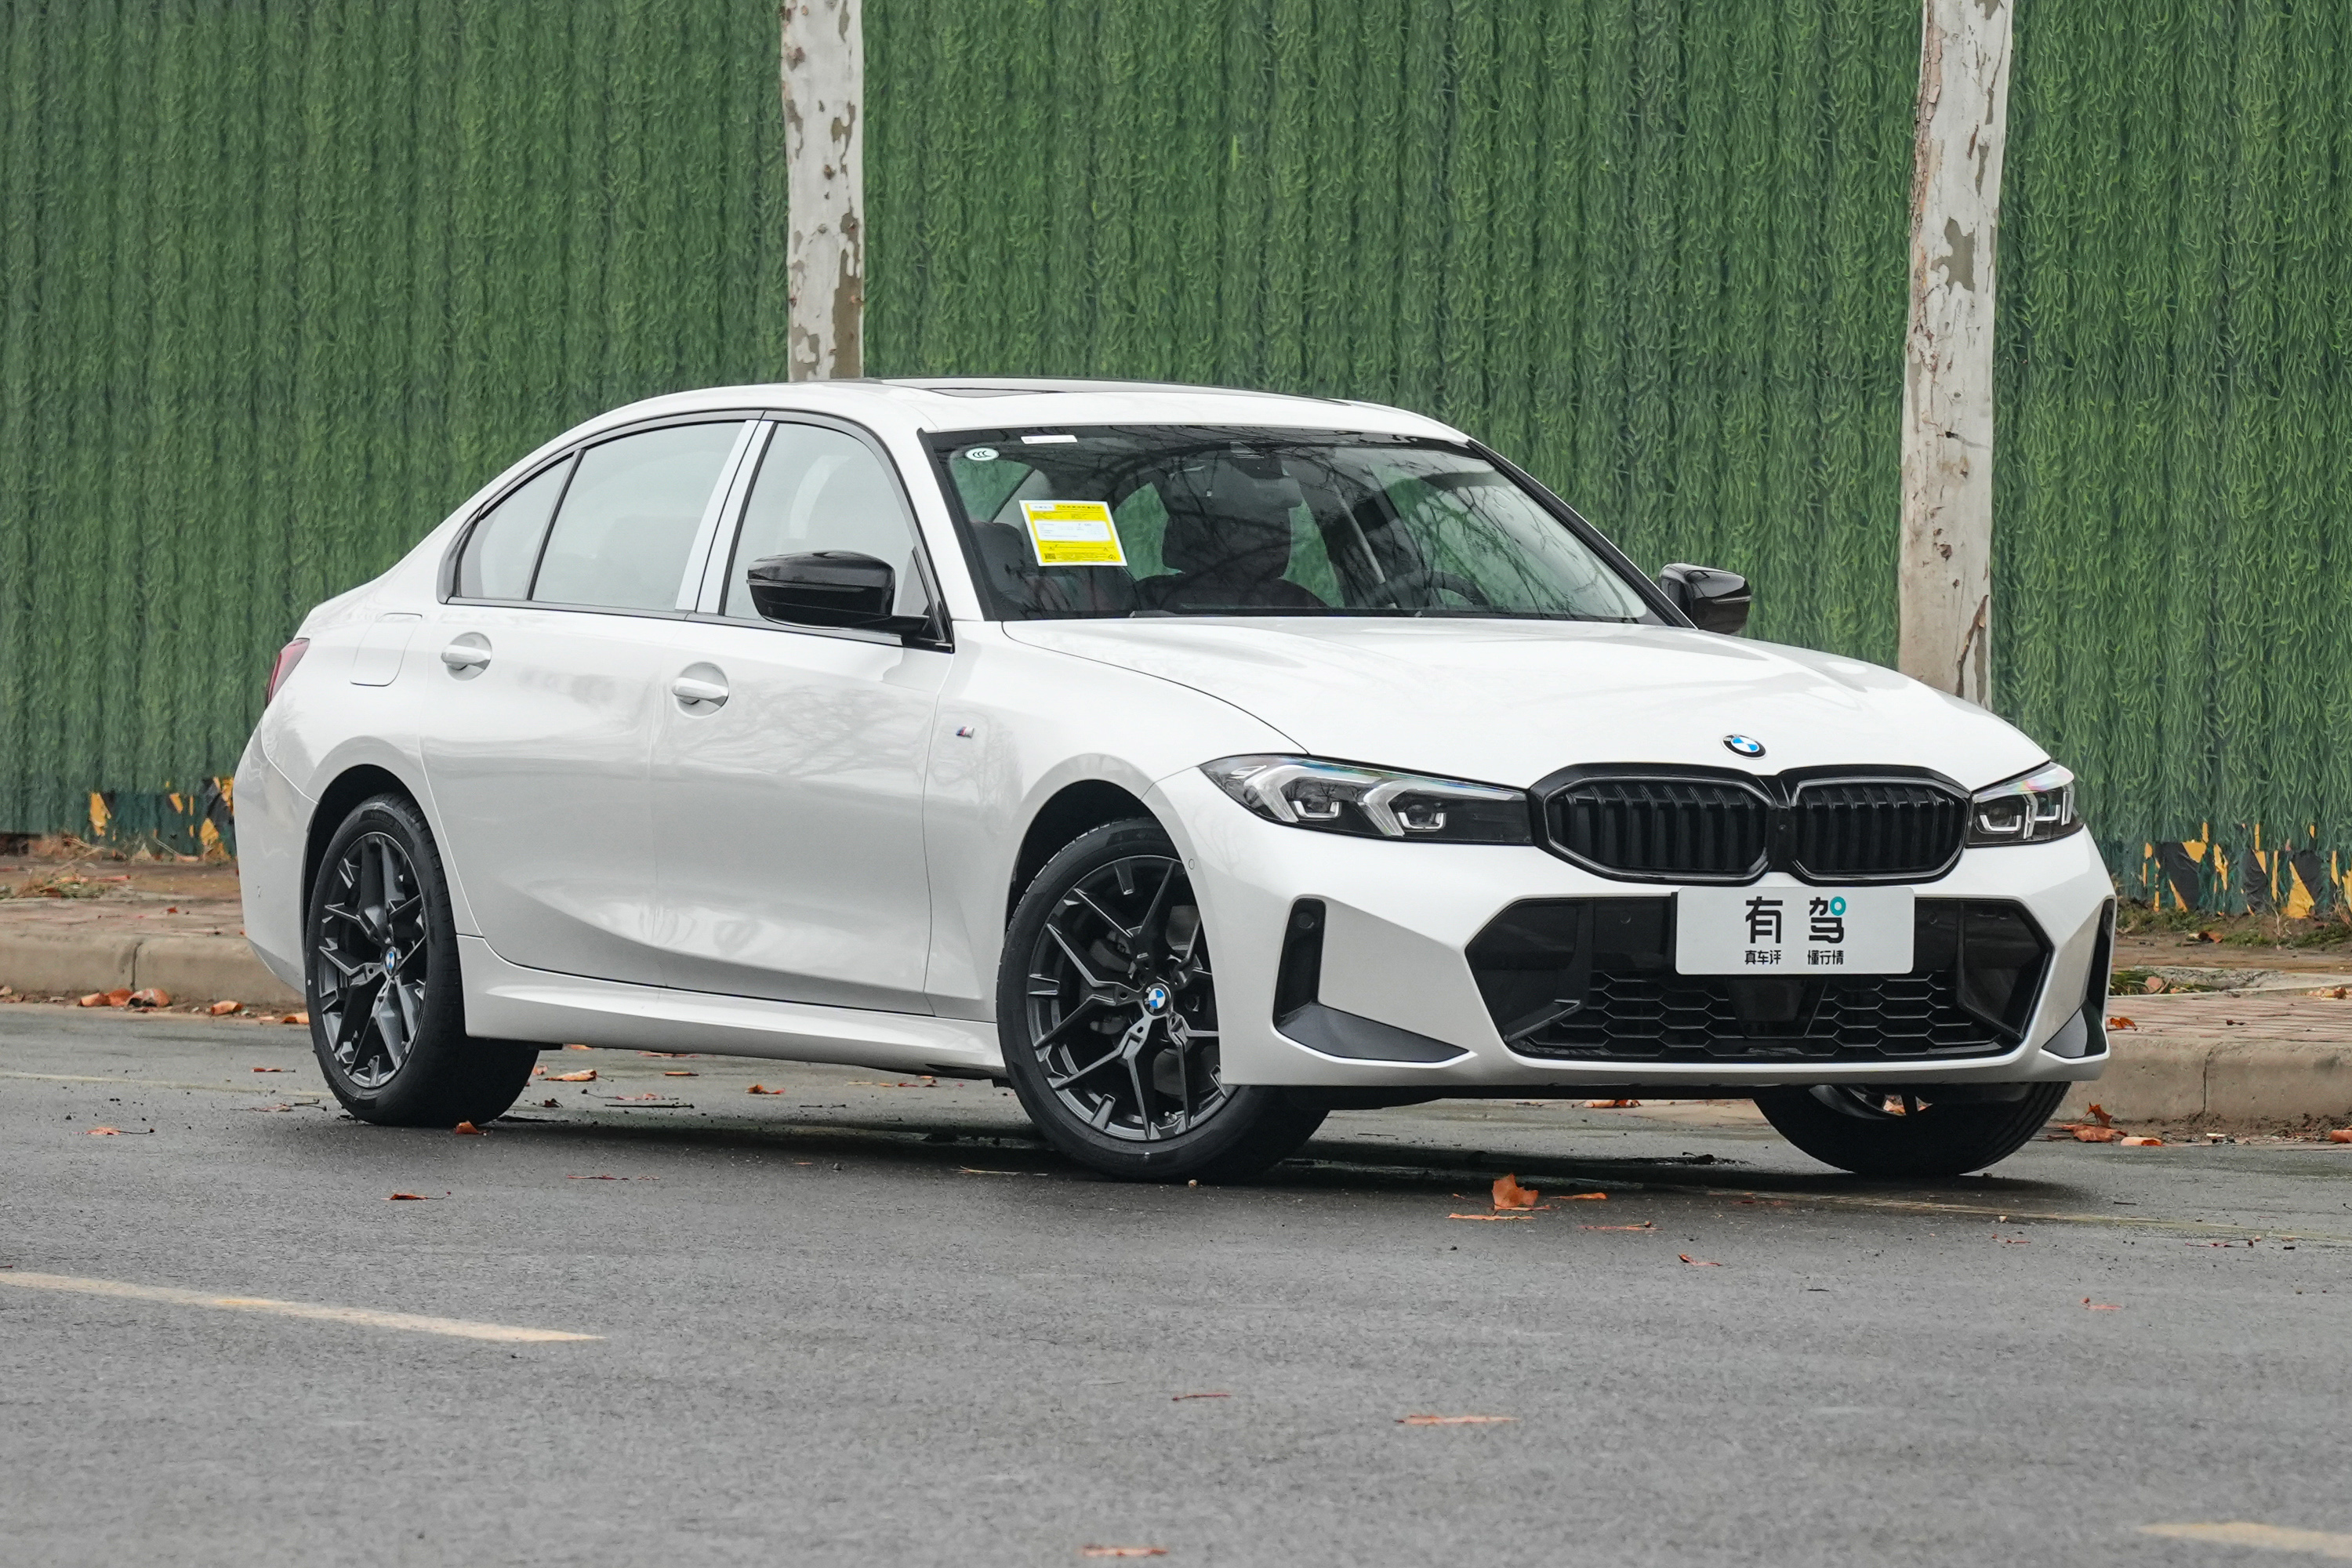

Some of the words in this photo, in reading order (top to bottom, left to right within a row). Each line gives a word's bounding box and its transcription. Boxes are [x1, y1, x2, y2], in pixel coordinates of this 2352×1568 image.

[1744, 949, 1781, 965] 真车评
[1808, 949, 1844, 965] 懂行情
